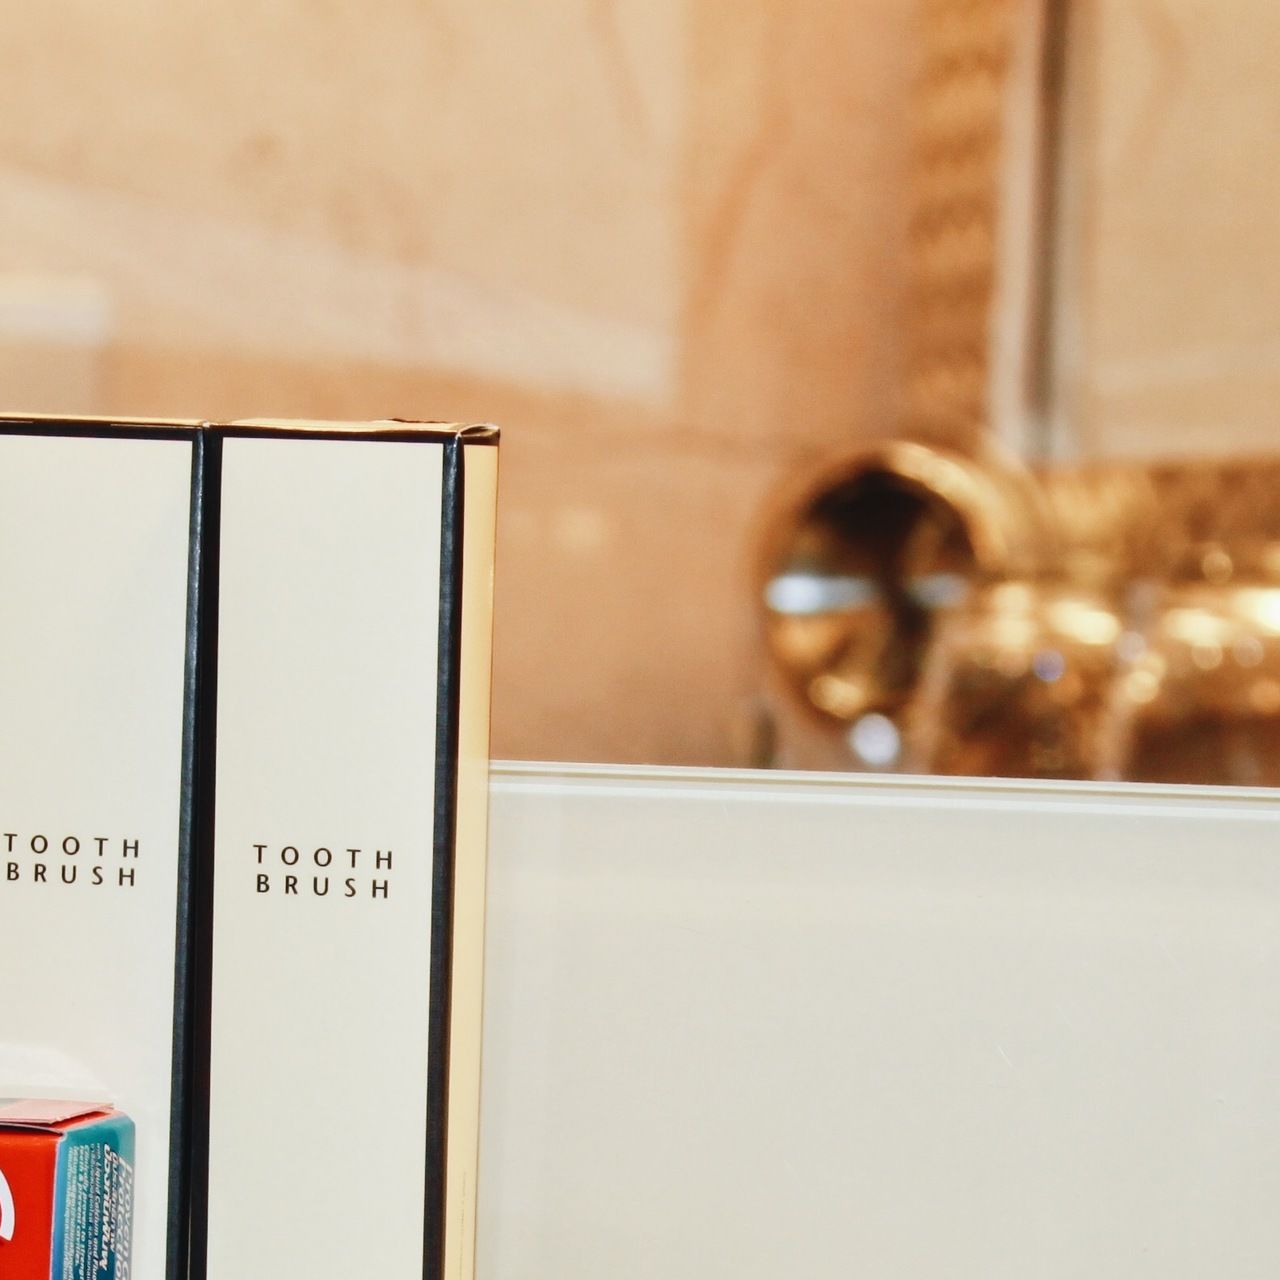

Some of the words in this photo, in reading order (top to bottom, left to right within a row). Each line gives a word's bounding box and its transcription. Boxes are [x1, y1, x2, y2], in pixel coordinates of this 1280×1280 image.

[3, 833, 140, 859] TOOTH
[252, 844, 393, 870] TOOTH
[5, 861, 136, 888] BRUSH
[255, 873, 389, 899] BRUSH
[122, 1163, 133, 1257] Proven
